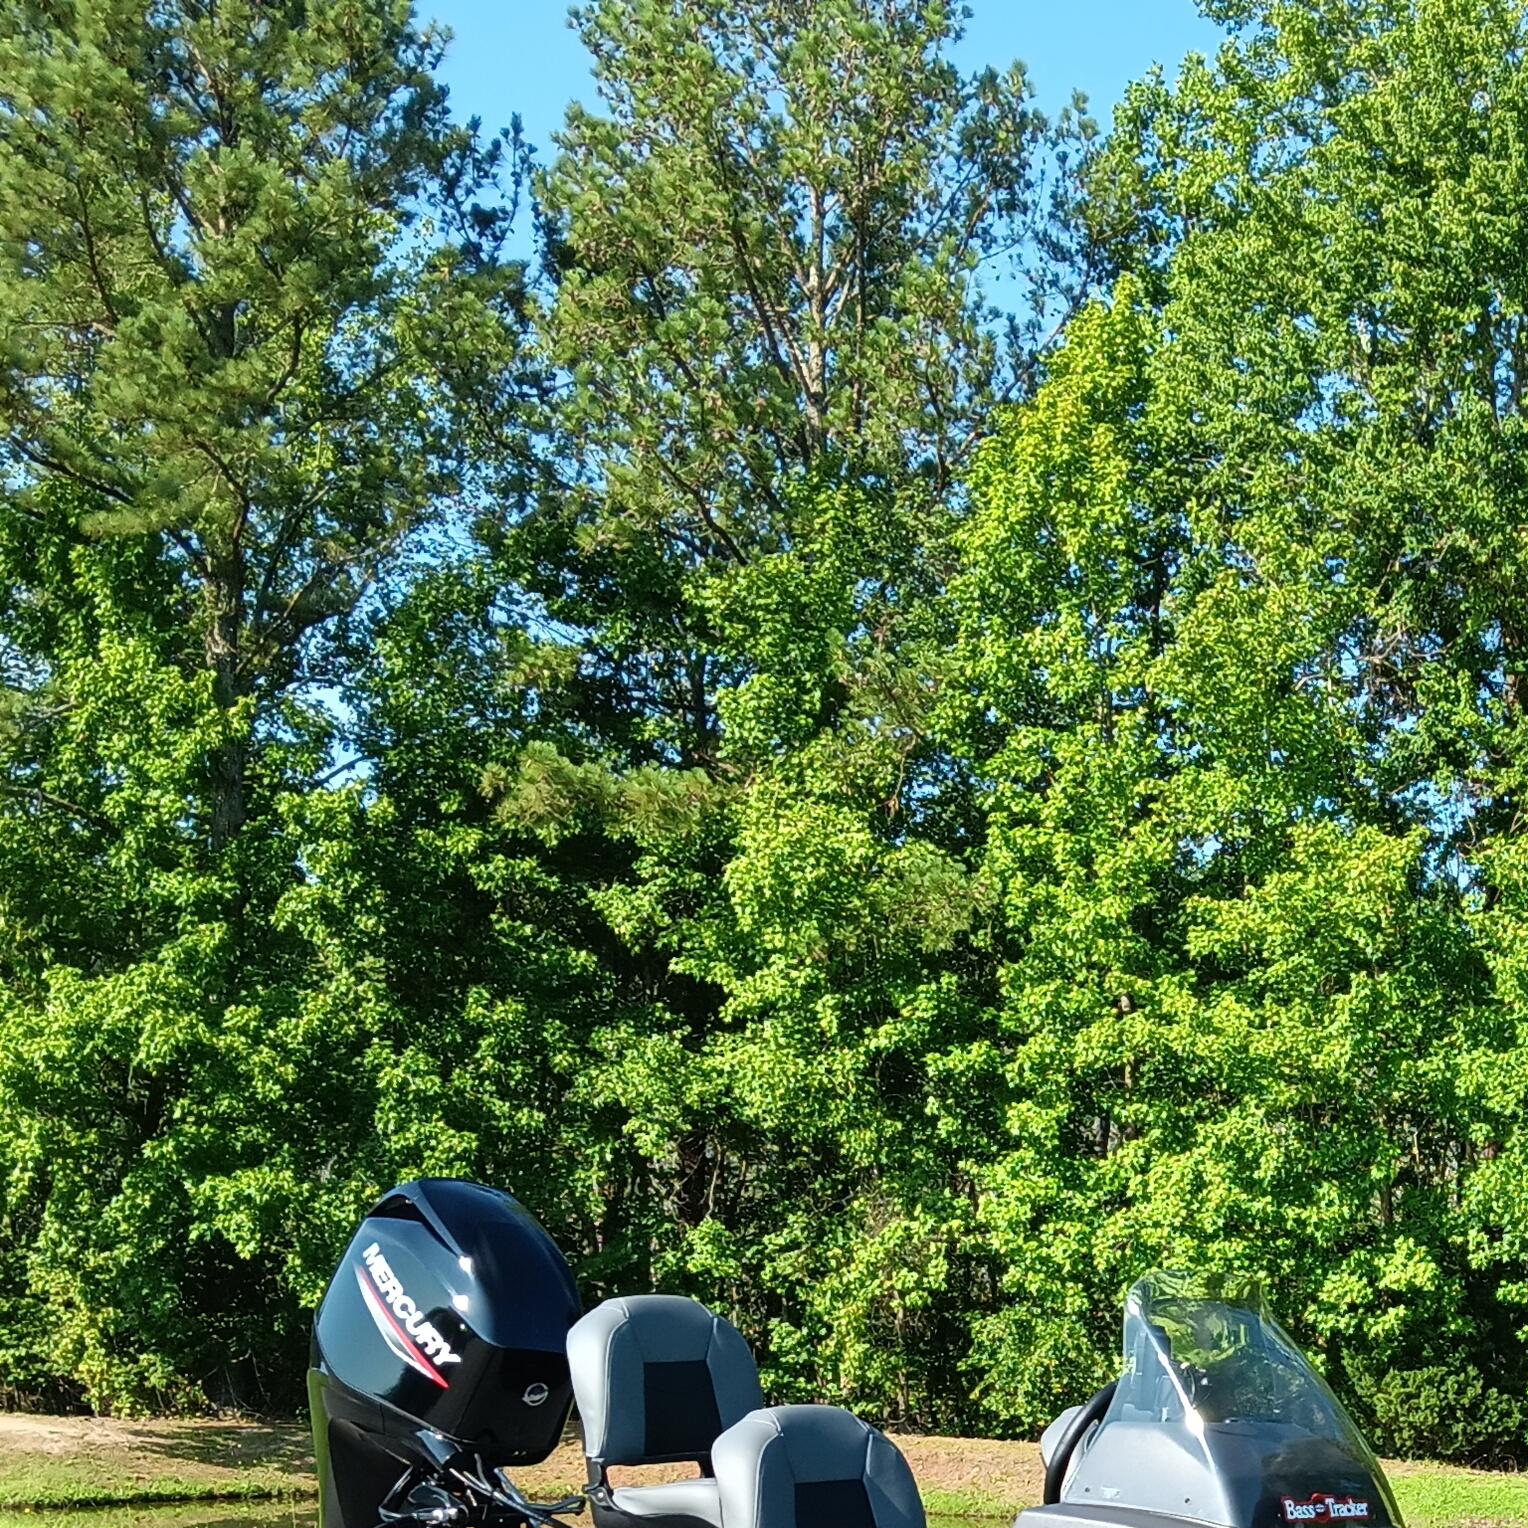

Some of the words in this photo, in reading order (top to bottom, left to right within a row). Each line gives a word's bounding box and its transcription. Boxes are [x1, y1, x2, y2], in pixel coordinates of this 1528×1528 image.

[363, 1242, 461, 1365] MERCURY
[1284, 1500, 1315, 1519] Bass
[1325, 1498, 1368, 1517] Tracker
